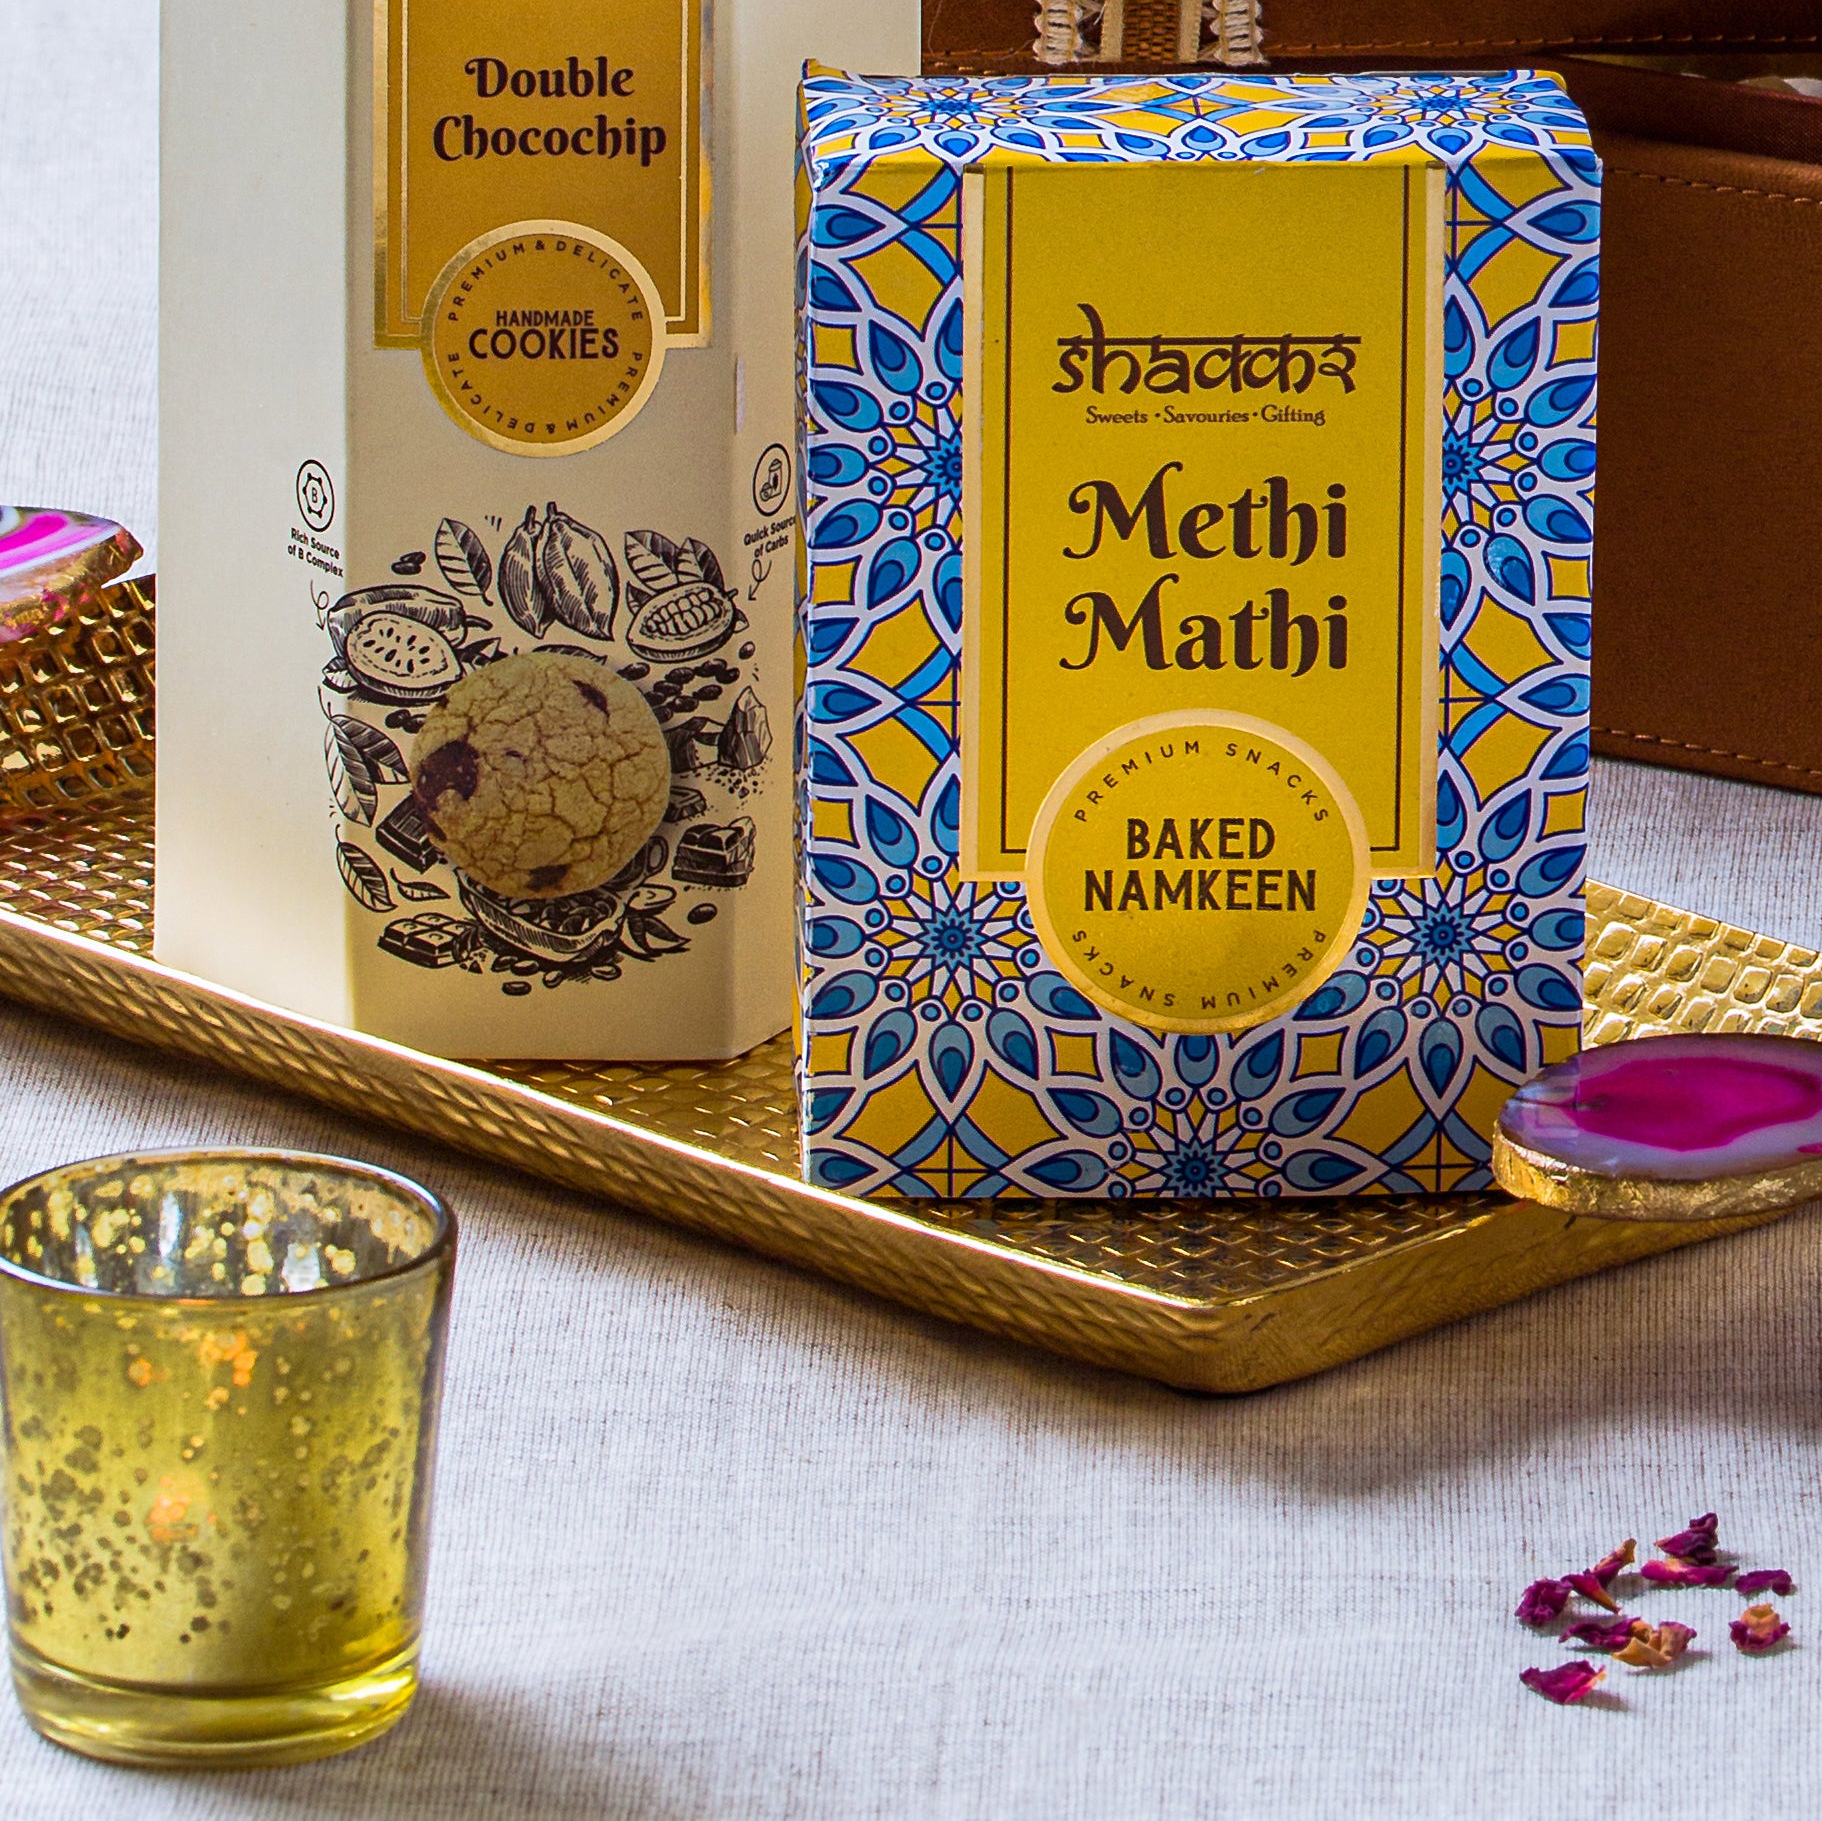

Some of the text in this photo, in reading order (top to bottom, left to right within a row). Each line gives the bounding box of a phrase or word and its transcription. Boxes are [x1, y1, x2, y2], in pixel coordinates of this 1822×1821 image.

[464, 56, 635, 98] Double
[433, 114, 667, 167] Chocochip
[449, 240, 643, 322] PREMIUM & DELICATE
[496, 310, 594, 327] HANDMADE
[468, 328, 620, 360] COOKIES
[448, 352, 535, 434] DELICATE
[566, 351, 643, 431] PREMIUM
[1086, 404, 1326, 427] Sweets Savouries Gifting
[1062, 461, 1347, 567] Methi
[291, 528, 340, 560] Rich Source
[743, 525, 769, 546] Quick
[754, 535, 789, 558] of Carbs
[288, 544, 344, 578] of B Complex
[1059, 572, 1348, 678] Mathi
[1074, 740, 1329, 823] PREMIUM SNACKS
[1126, 818, 1275, 860] BAKED
[1084, 869, 1317, 912] NAMKEEN
[1072, 930, 1326, 1010] PREMIUM SNACKS
